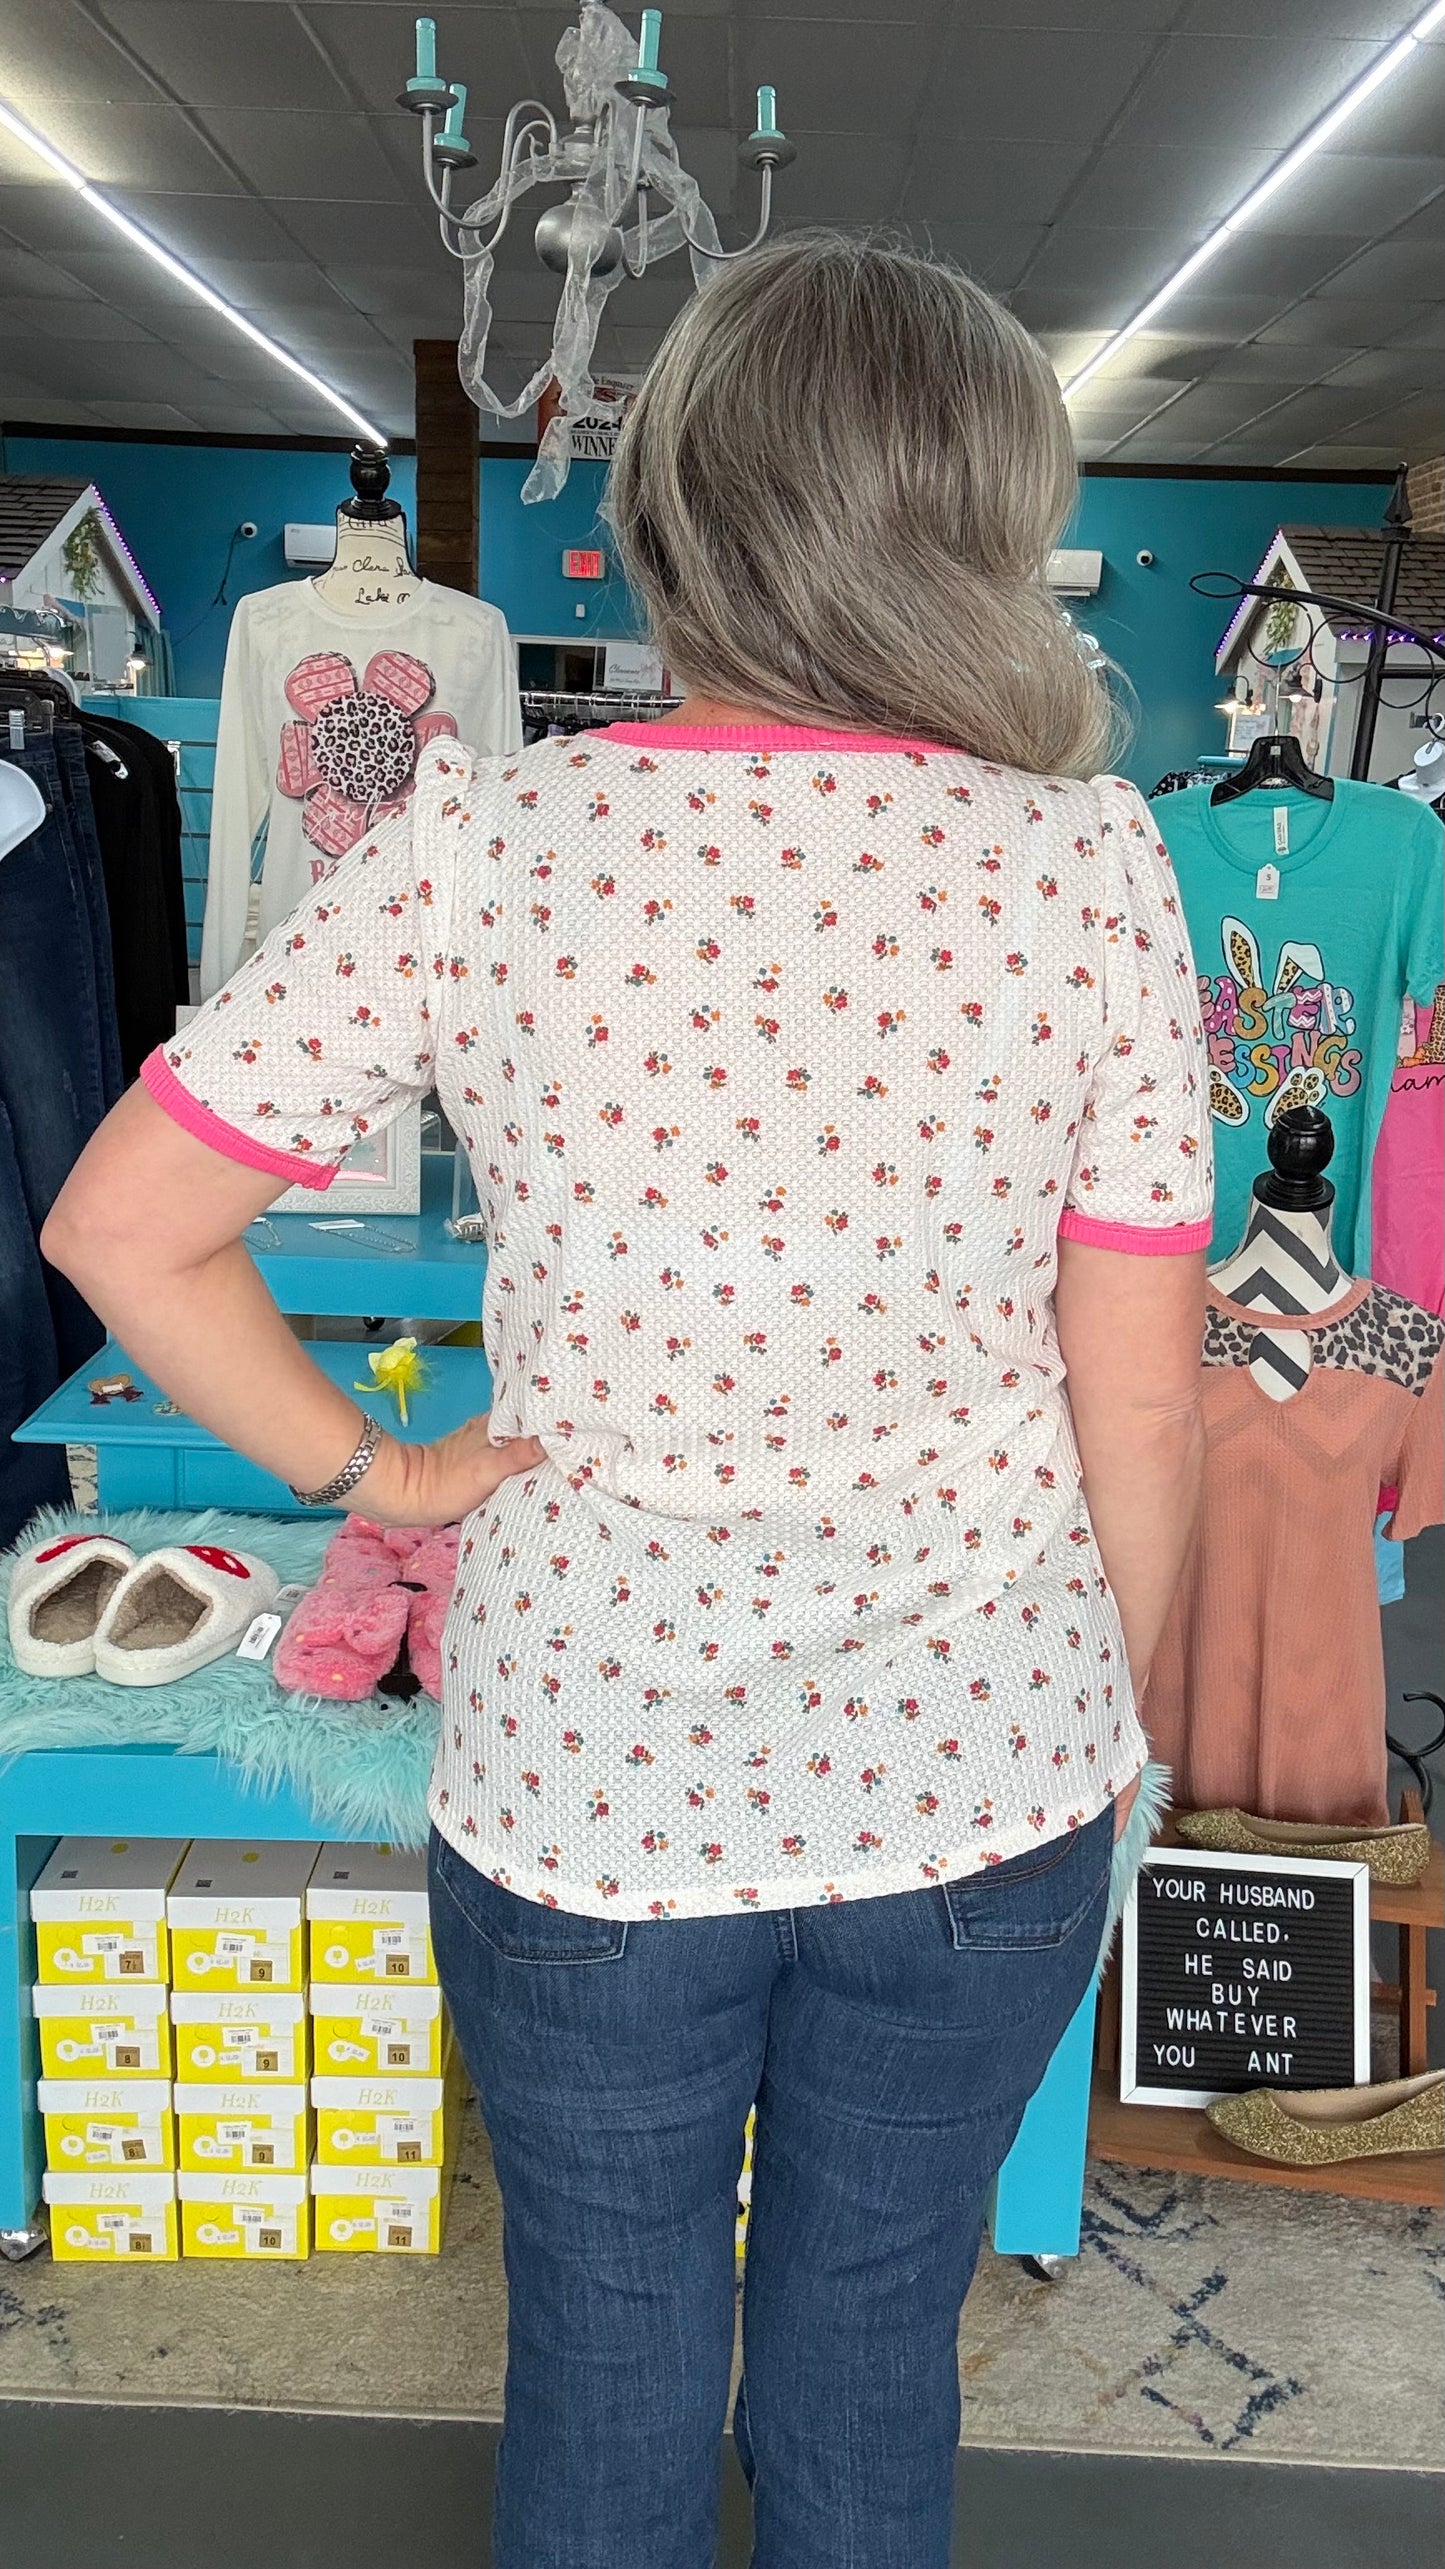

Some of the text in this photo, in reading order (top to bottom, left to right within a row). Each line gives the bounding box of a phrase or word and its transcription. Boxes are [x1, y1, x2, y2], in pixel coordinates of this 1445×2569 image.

[571, 435, 618, 457] WINNE
[570, 551, 599, 576] EXIT
[1265, 873, 1272, 882] S
[1207, 1031, 1363, 1098] ESSINGS
[1152, 1877, 1316, 1911] YOUR HUSBAND
[78, 1896, 120, 1912] H2K
[351, 1898, 392, 1915] H2K
[214, 1907, 255, 1924] H2K
[258, 1967, 266, 1978] 9
[391, 1963, 405, 1973] 10
[1184, 1952, 1293, 1982] HE SAID
[79, 1994, 120, 2011] H2K
[355, 1993, 396, 2011] H2K
[1211, 1982, 1260, 2007] BUY
[218, 2002, 258, 2018] H2K
[1166, 2007, 1298, 2039] WHATEVER
[124, 2054, 131, 2064] 8
[262, 2058, 271, 2069] 9
[391, 2052, 405, 2063] 10
[1153, 2043, 1294, 2076] YOU ANT
[84, 2090, 123, 2107] H2K
[220, 2093, 261, 2109] H2K
[358, 2088, 399, 2105] H2K
[258, 2151, 266, 2162] 9
[404, 2150, 416, 2160] 11
[221, 2178, 263, 2196] H2K
[355, 2171, 396, 2188] H2K
[89, 2182, 130, 2199] H2K
[263, 2236, 277, 2246] 10
[394, 2236, 408, 2246] 11
